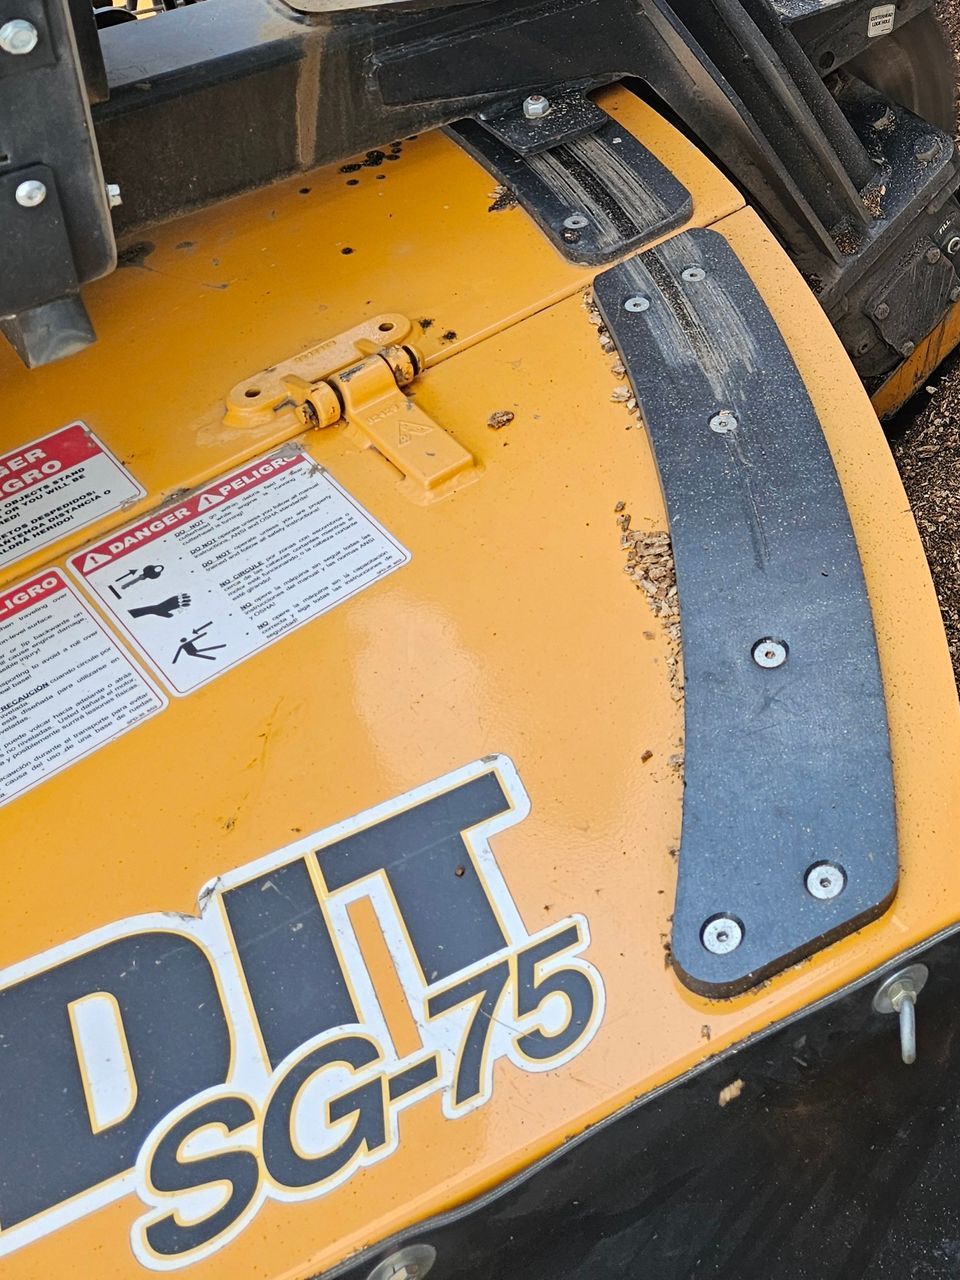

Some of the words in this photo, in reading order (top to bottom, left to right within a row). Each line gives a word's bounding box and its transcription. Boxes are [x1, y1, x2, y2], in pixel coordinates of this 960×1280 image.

[939, 220, 951, 234] FILL
[4, 484, 50, 508] OBJECTS
[52, 467, 85, 485] STAND
[5, 505, 20, 516] OR
[22, 494, 43, 507] YOU
[45, 482, 70, 496] WILL
[72, 474, 86, 483] BE
[48, 495, 102, 524] DISTANCIA
[32, 515, 74, 538] HERIDO!
[109, 507, 191, 555] DANGER
[174, 529, 185, 537] DO
[189, 519, 203, 529] NOT
[189, 546, 201, 554] DO
[201, 538, 216, 548] NOT
[201, 559, 213, 567] DO
[215, 549, 230, 560] NOT
[219, 579, 230, 587] NO
[240, 602, 252, 610] NO
[257, 621, 268, 629] NO
[142, 923, 598, 1256] SG-75
